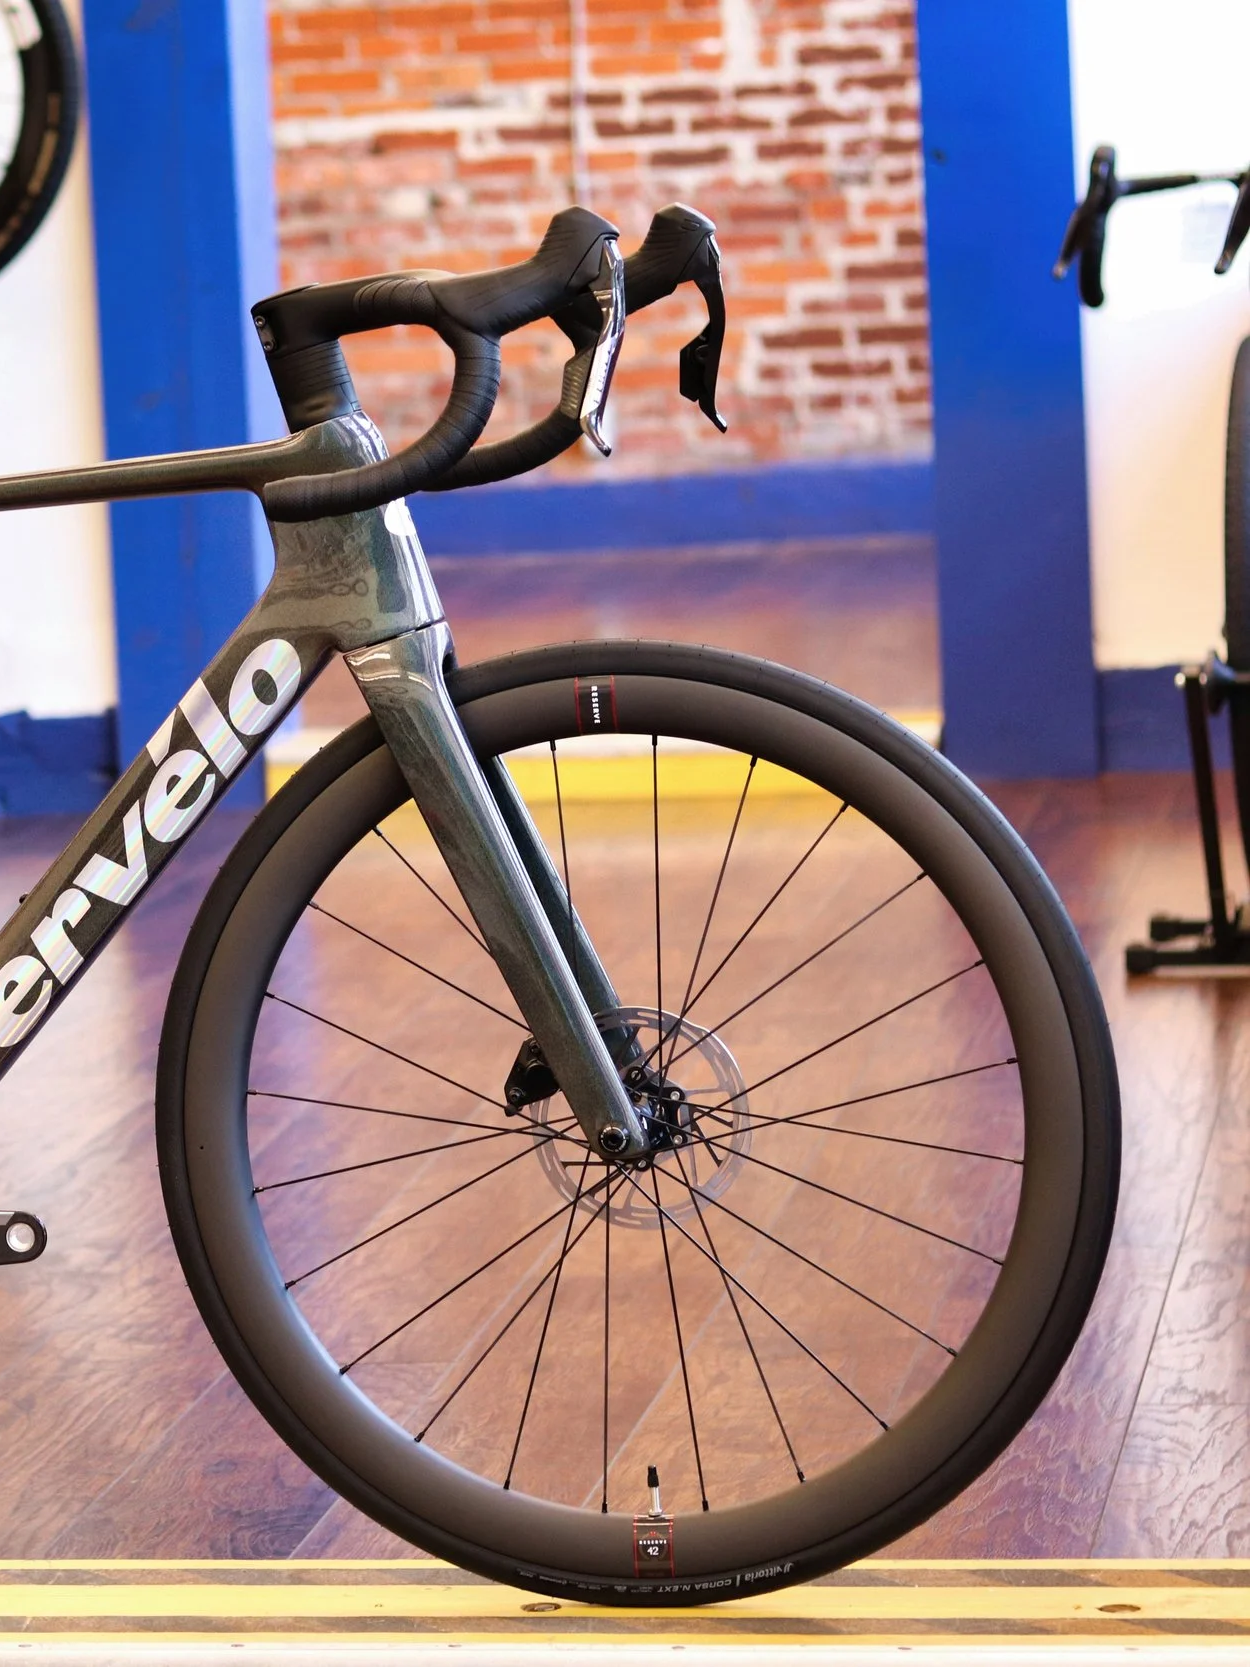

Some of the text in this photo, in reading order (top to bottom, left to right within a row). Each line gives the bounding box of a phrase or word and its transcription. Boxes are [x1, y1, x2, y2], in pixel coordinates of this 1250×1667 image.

[590, 685, 601, 724] RESERVE
[647, 1545, 659, 1556] 42
[744, 1565, 784, 1582] vittoria
[694, 1578, 733, 1590] CORSA
